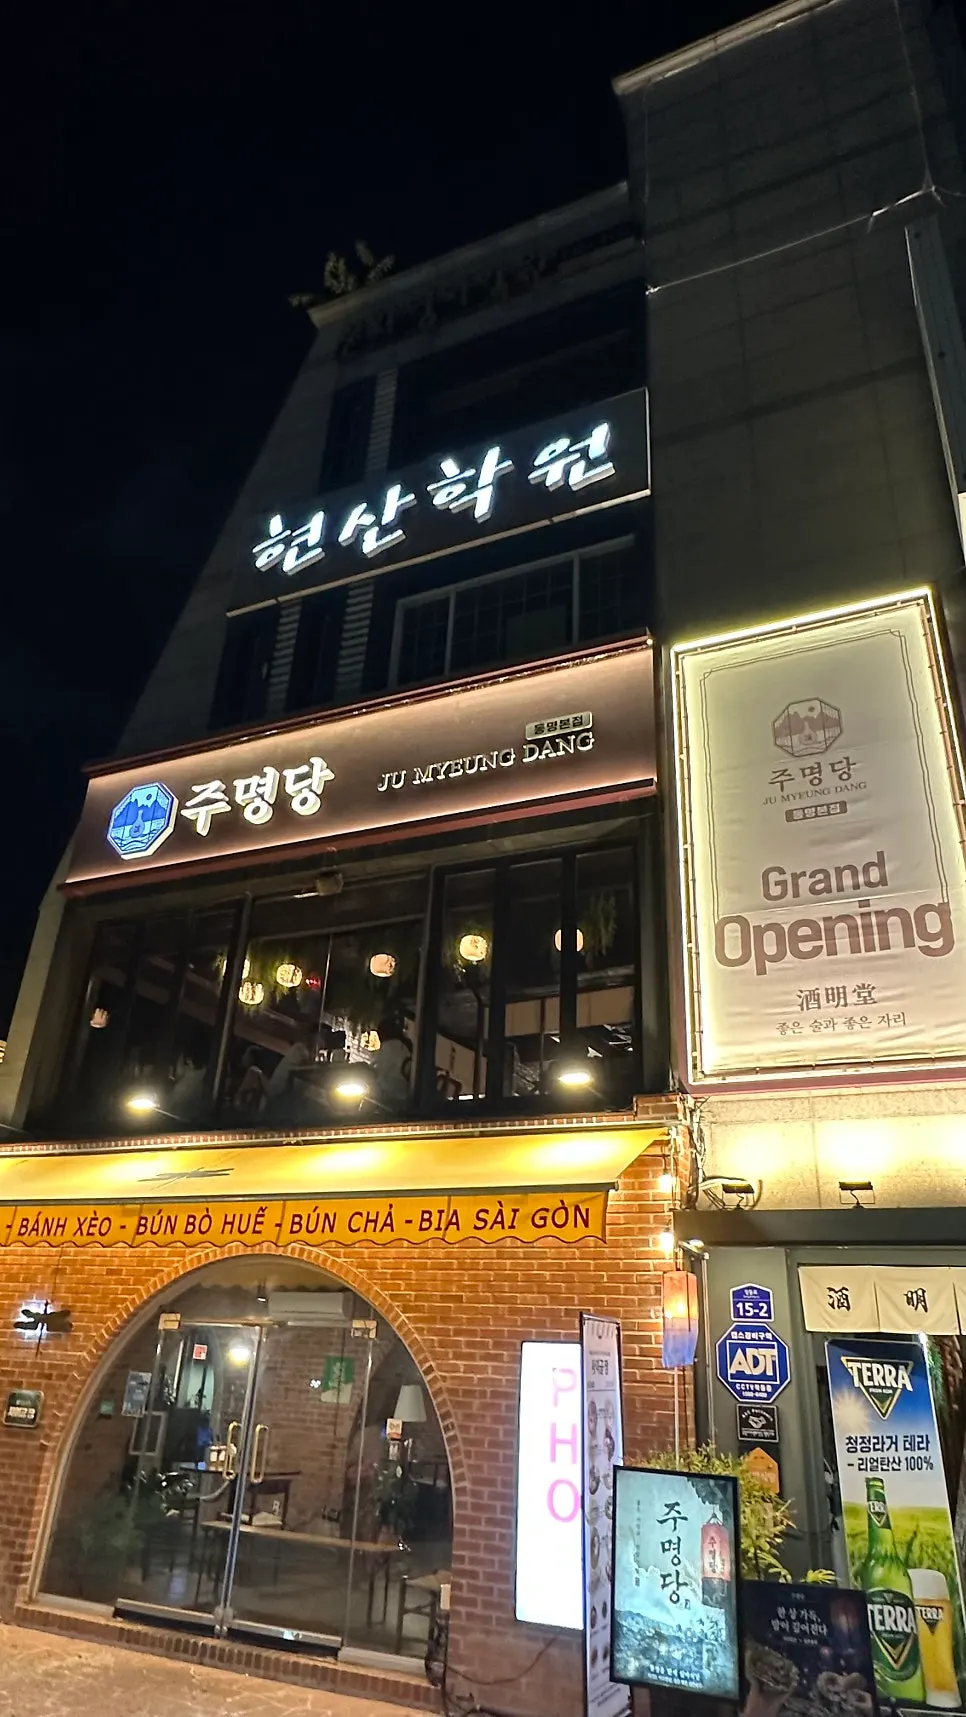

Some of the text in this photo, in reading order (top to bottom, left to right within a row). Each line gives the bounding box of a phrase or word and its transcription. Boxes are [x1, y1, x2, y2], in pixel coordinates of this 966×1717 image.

[252, 422, 616, 575] 현산학원
[534, 715, 583, 735] 동명본점
[377, 731, 595, 791] JU MYEUNG DANG
[768, 756, 857, 792] 주명당
[180, 757, 335, 837] 주명당
[763, 781, 867, 805] JU MYEUNG DANG
[760, 851, 889, 902] Grand
[714, 898, 955, 976] Opening
[796, 983, 878, 1011] 酒明堂
[776, 1011, 906, 1036] 좋은 술과 좋은 자리
[17, 1211, 68, 1236] BÁNH
[73, 1210, 112, 1236] XÈO
[136, 1209, 178, 1235] BÚN
[184, 1208, 212, 1235] BÒ
[220, 1206, 268, 1234] HUẾ
[289, 1206, 337, 1234] BÚN
[347, 1203, 396, 1233] CHẢ
[418, 1209, 461, 1232] BIA
[473, 1201, 519, 1231] SÀI
[531, 1200, 590, 1229] GÒN
[736, 1302, 768, 1317] 15-2
[730, 1347, 776, 1376] ADT
[847, 1361, 913, 1392] TERRA
[547, 1368, 580, 1522] PHO
[845, 1434, 931, 1453] 청정라거 테라
[857, 1456, 902, 1471] 리얼탄산
[905, 1455, 934, 1471] 100%
[656, 1501, 689, 1604] 주명당
